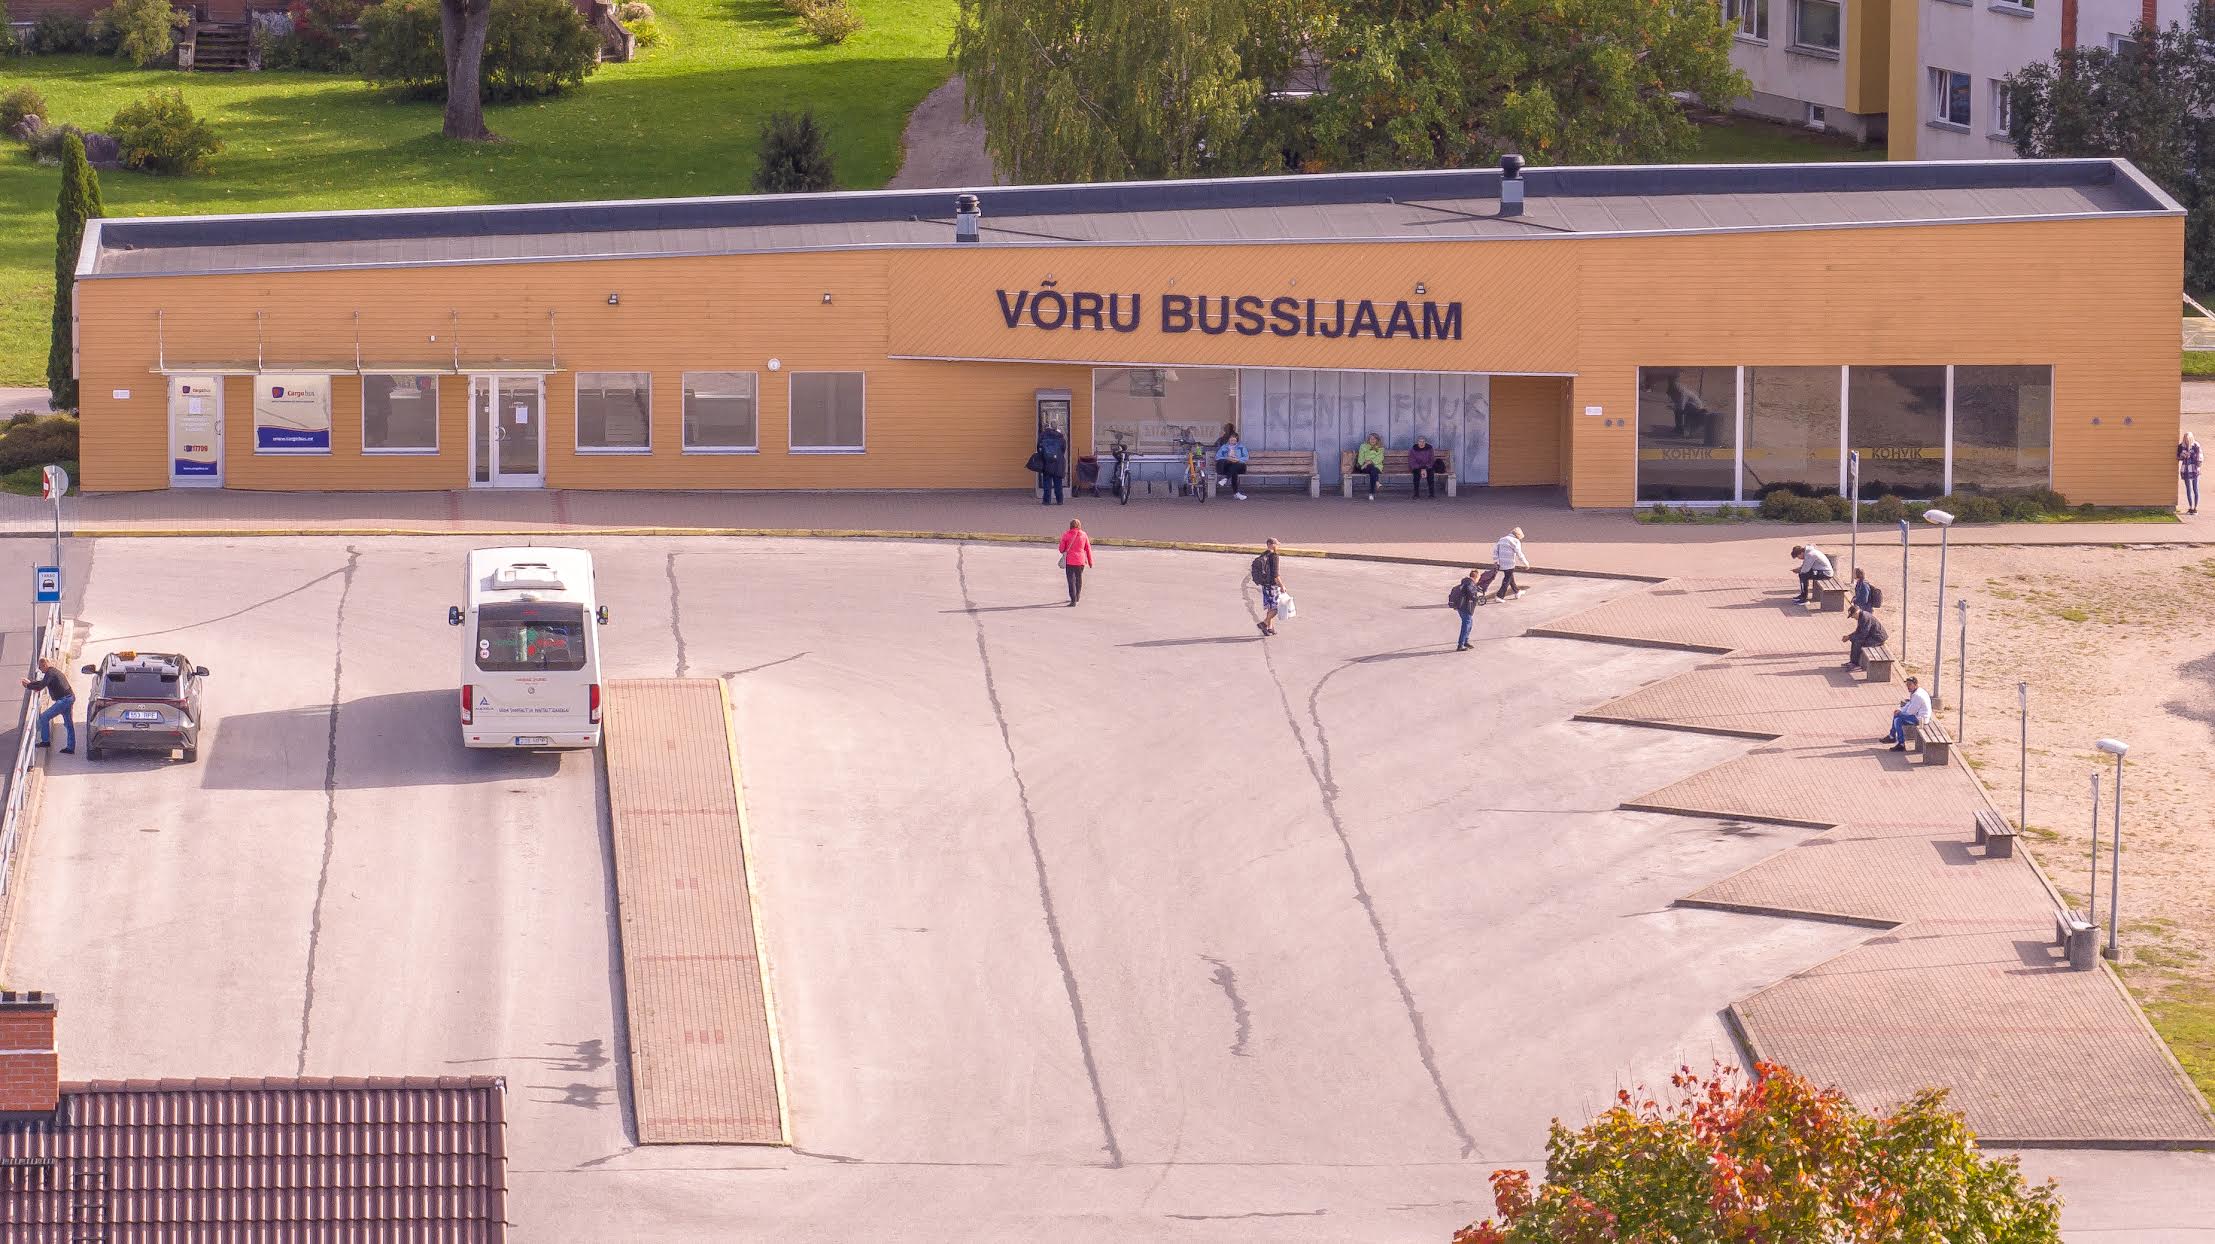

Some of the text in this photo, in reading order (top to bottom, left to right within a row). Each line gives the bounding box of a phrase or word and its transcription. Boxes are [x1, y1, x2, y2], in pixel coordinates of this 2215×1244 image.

[996, 280, 1462, 341] VÕRU BUSSIJAAM
[287, 389, 315, 397] Cargobus
[1662, 448, 1712, 461] KOHVIK
[1871, 447, 1922, 459] KOHVIK
